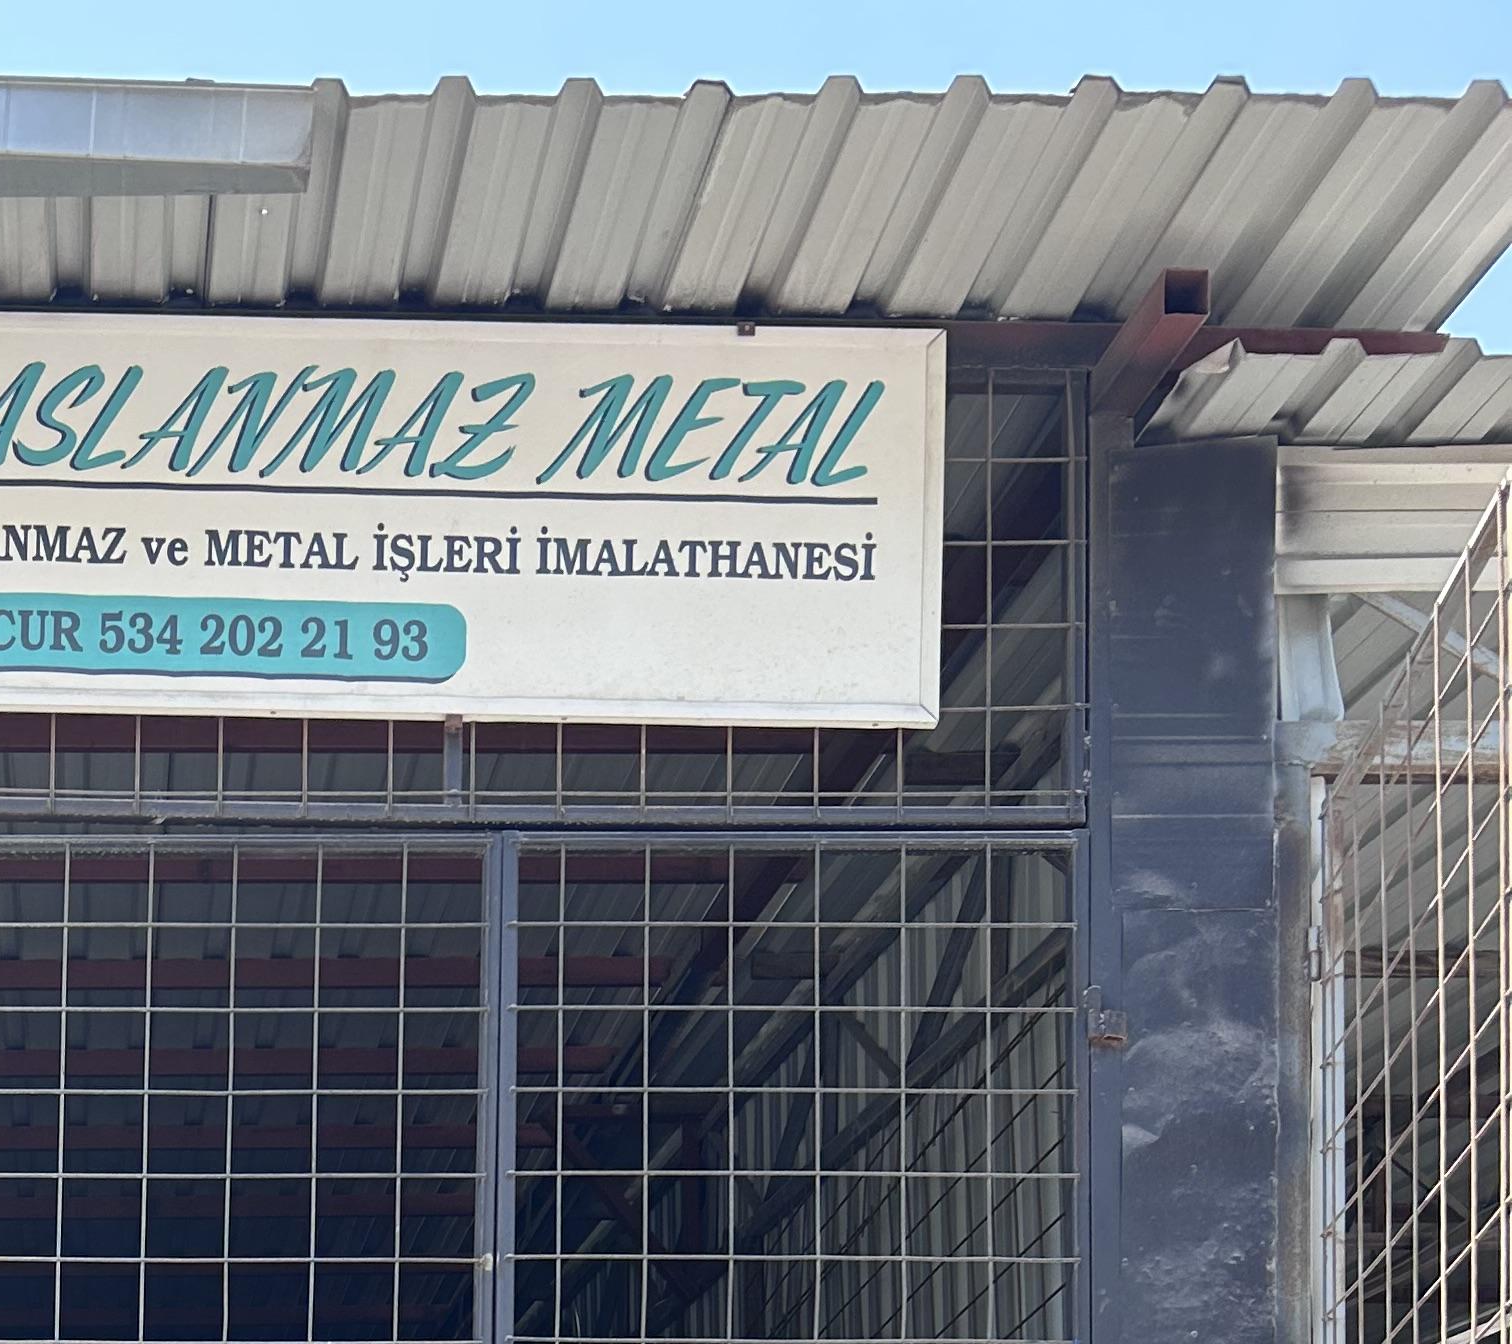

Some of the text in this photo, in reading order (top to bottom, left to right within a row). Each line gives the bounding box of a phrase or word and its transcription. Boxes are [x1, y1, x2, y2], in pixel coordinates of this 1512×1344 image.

[535, 373, 886, 488] METAL
[140, 536, 189, 567] ve
[203, 529, 360, 572] METAL
[372, 522, 522, 583] İŞLERİ
[535, 525, 878, 582] İMALATHANESİ
[98, 609, 184, 656] 534
[199, 613, 284, 659] 202
[300, 616, 354, 661] 21
[372, 618, 430, 663] 93
